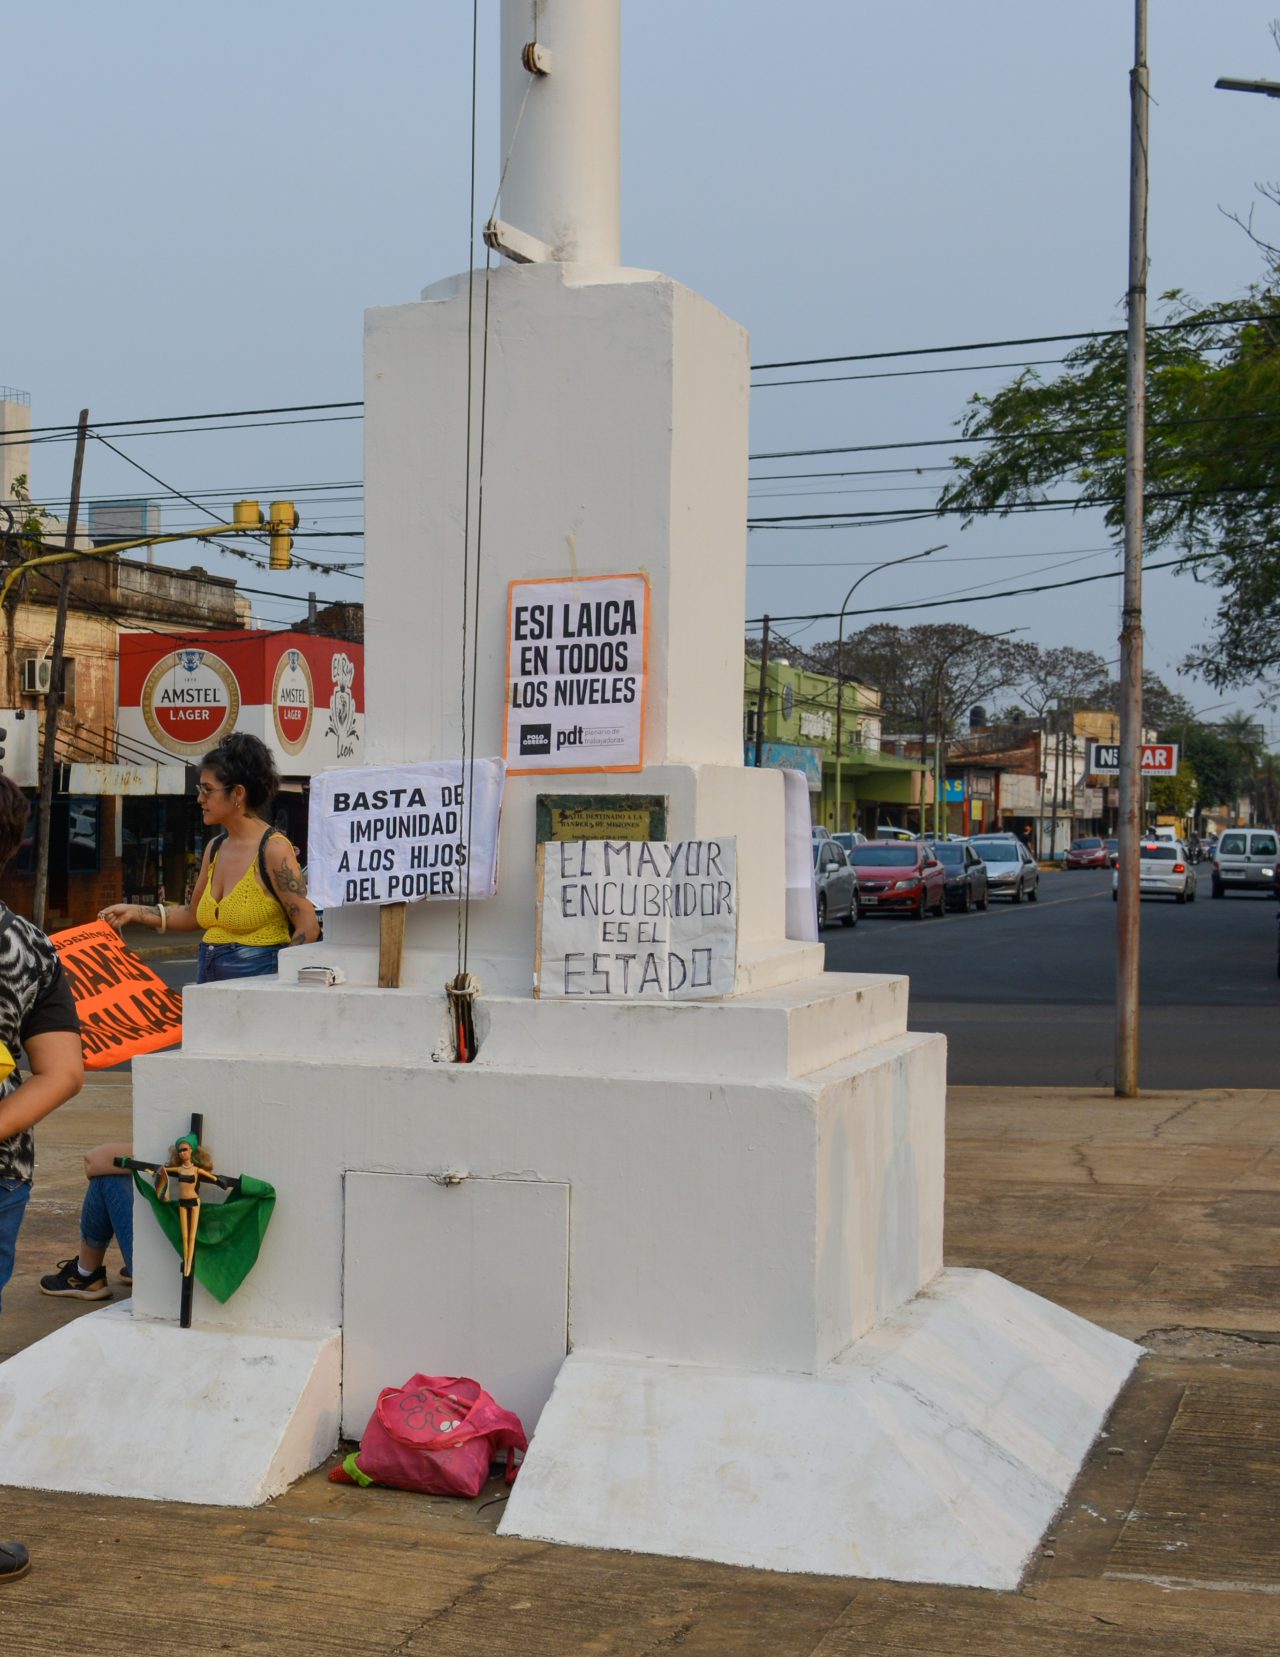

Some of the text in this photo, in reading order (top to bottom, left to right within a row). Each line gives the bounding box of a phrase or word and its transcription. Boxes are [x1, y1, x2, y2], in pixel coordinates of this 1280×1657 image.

[515, 600, 637, 641] ESI LAICA
[521, 641, 628, 676] EN TODOS
[161, 688, 221, 703] AMSTEL
[280, 688, 306, 703] AMSTEL
[512, 677, 636, 709] LOS NIVELES
[170, 710, 210, 720] LAGER
[284, 709, 301, 720] LAGER
[557, 725, 583, 751] pdt
[585, 737, 624, 745] trabajadoras
[333, 784, 465, 812] BASTA DE
[350, 811, 457, 843] IMPUNIDAD
[338, 843, 467, 873] A LOS HIJOS
[561, 840, 723, 878] EL MAYOR
[346, 871, 454, 902] DEL PODER
[562, 881, 734, 918] ENCUBRIDOR
[603, 922, 667, 943] ES EL
[565, 948, 712, 994] ESTADO
